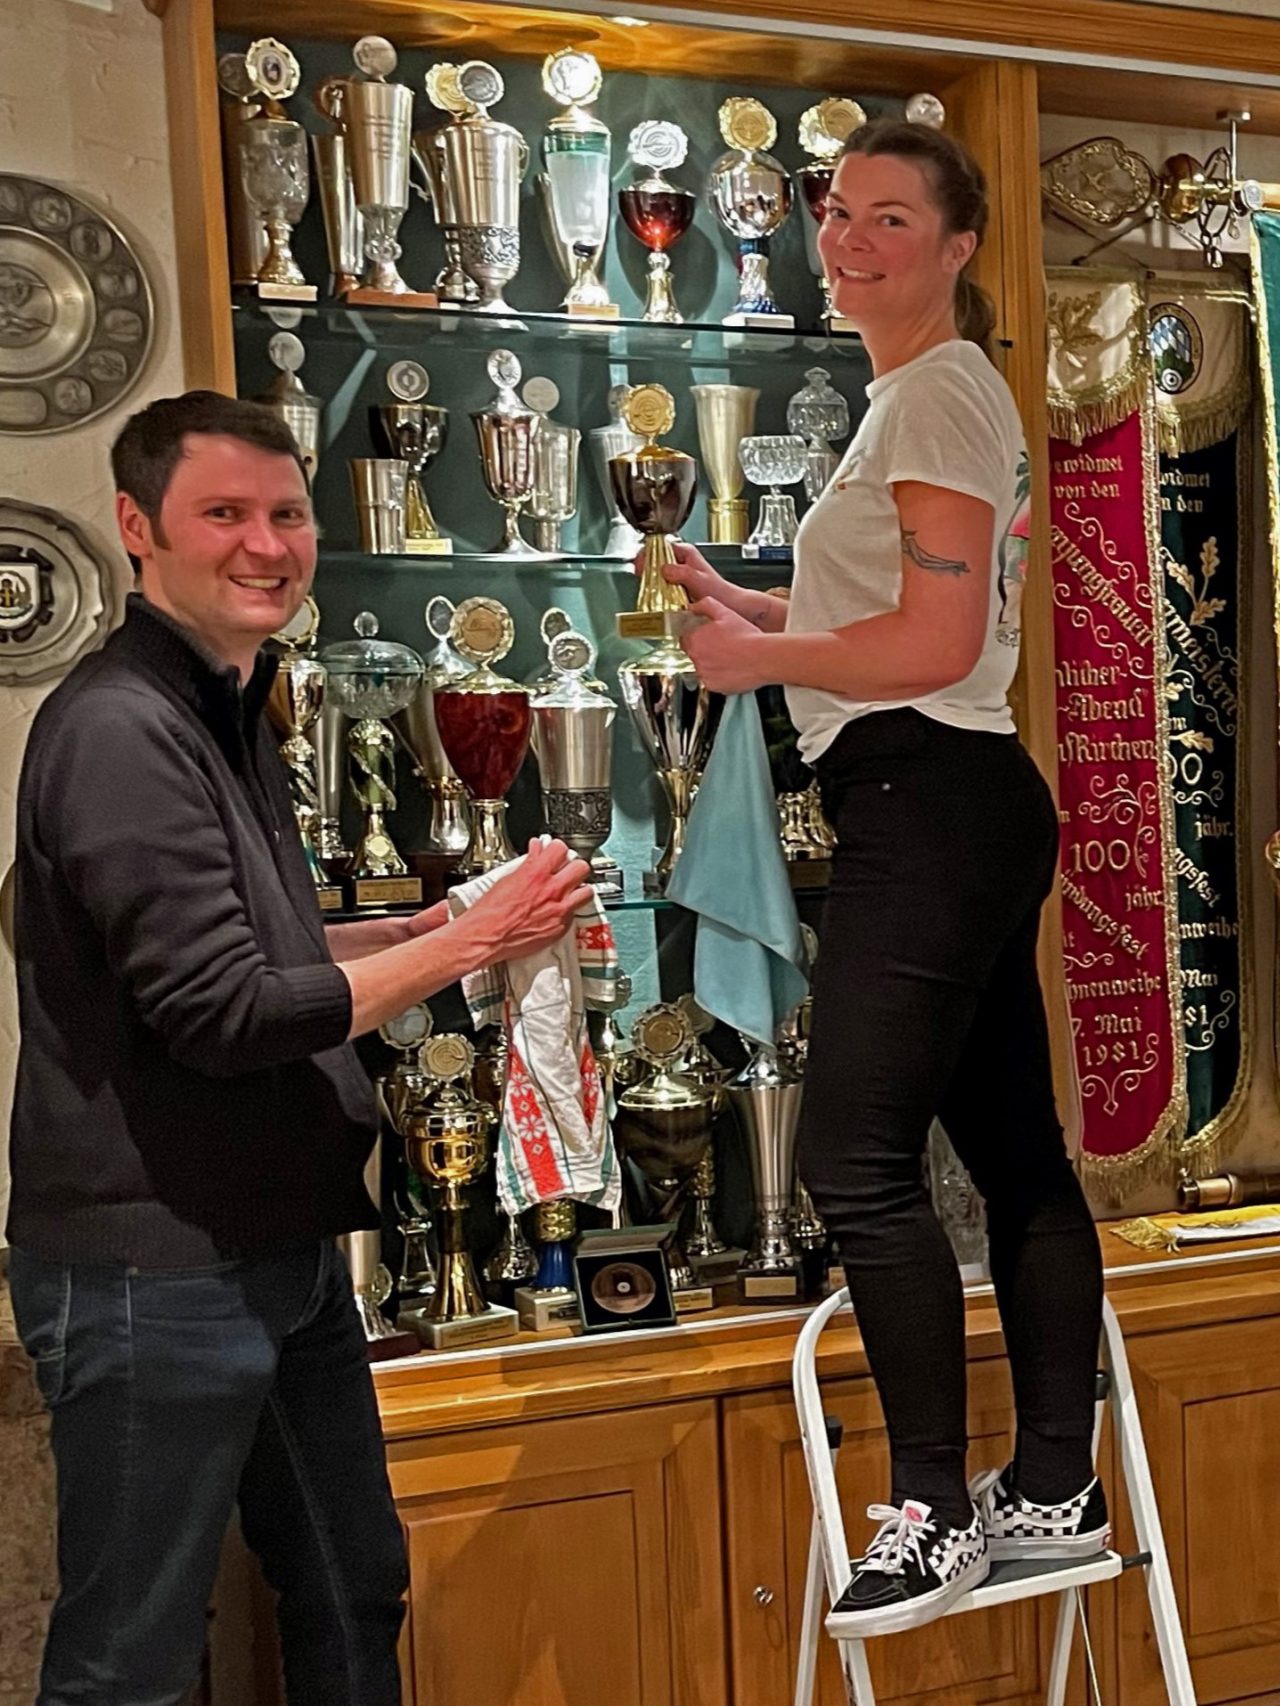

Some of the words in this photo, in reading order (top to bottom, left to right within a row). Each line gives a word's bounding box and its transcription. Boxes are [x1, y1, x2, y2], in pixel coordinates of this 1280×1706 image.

[1053, 453, 1125, 474] ewidmet
[1054, 484, 1086, 499] von
[1090, 480, 1121, 498] den
[1069, 838, 1131, 873] 100
[1174, 847, 1221, 909] ngsfest
[1094, 1005, 1143, 1035] Mai
[1082, 1040, 1140, 1067] 1981
